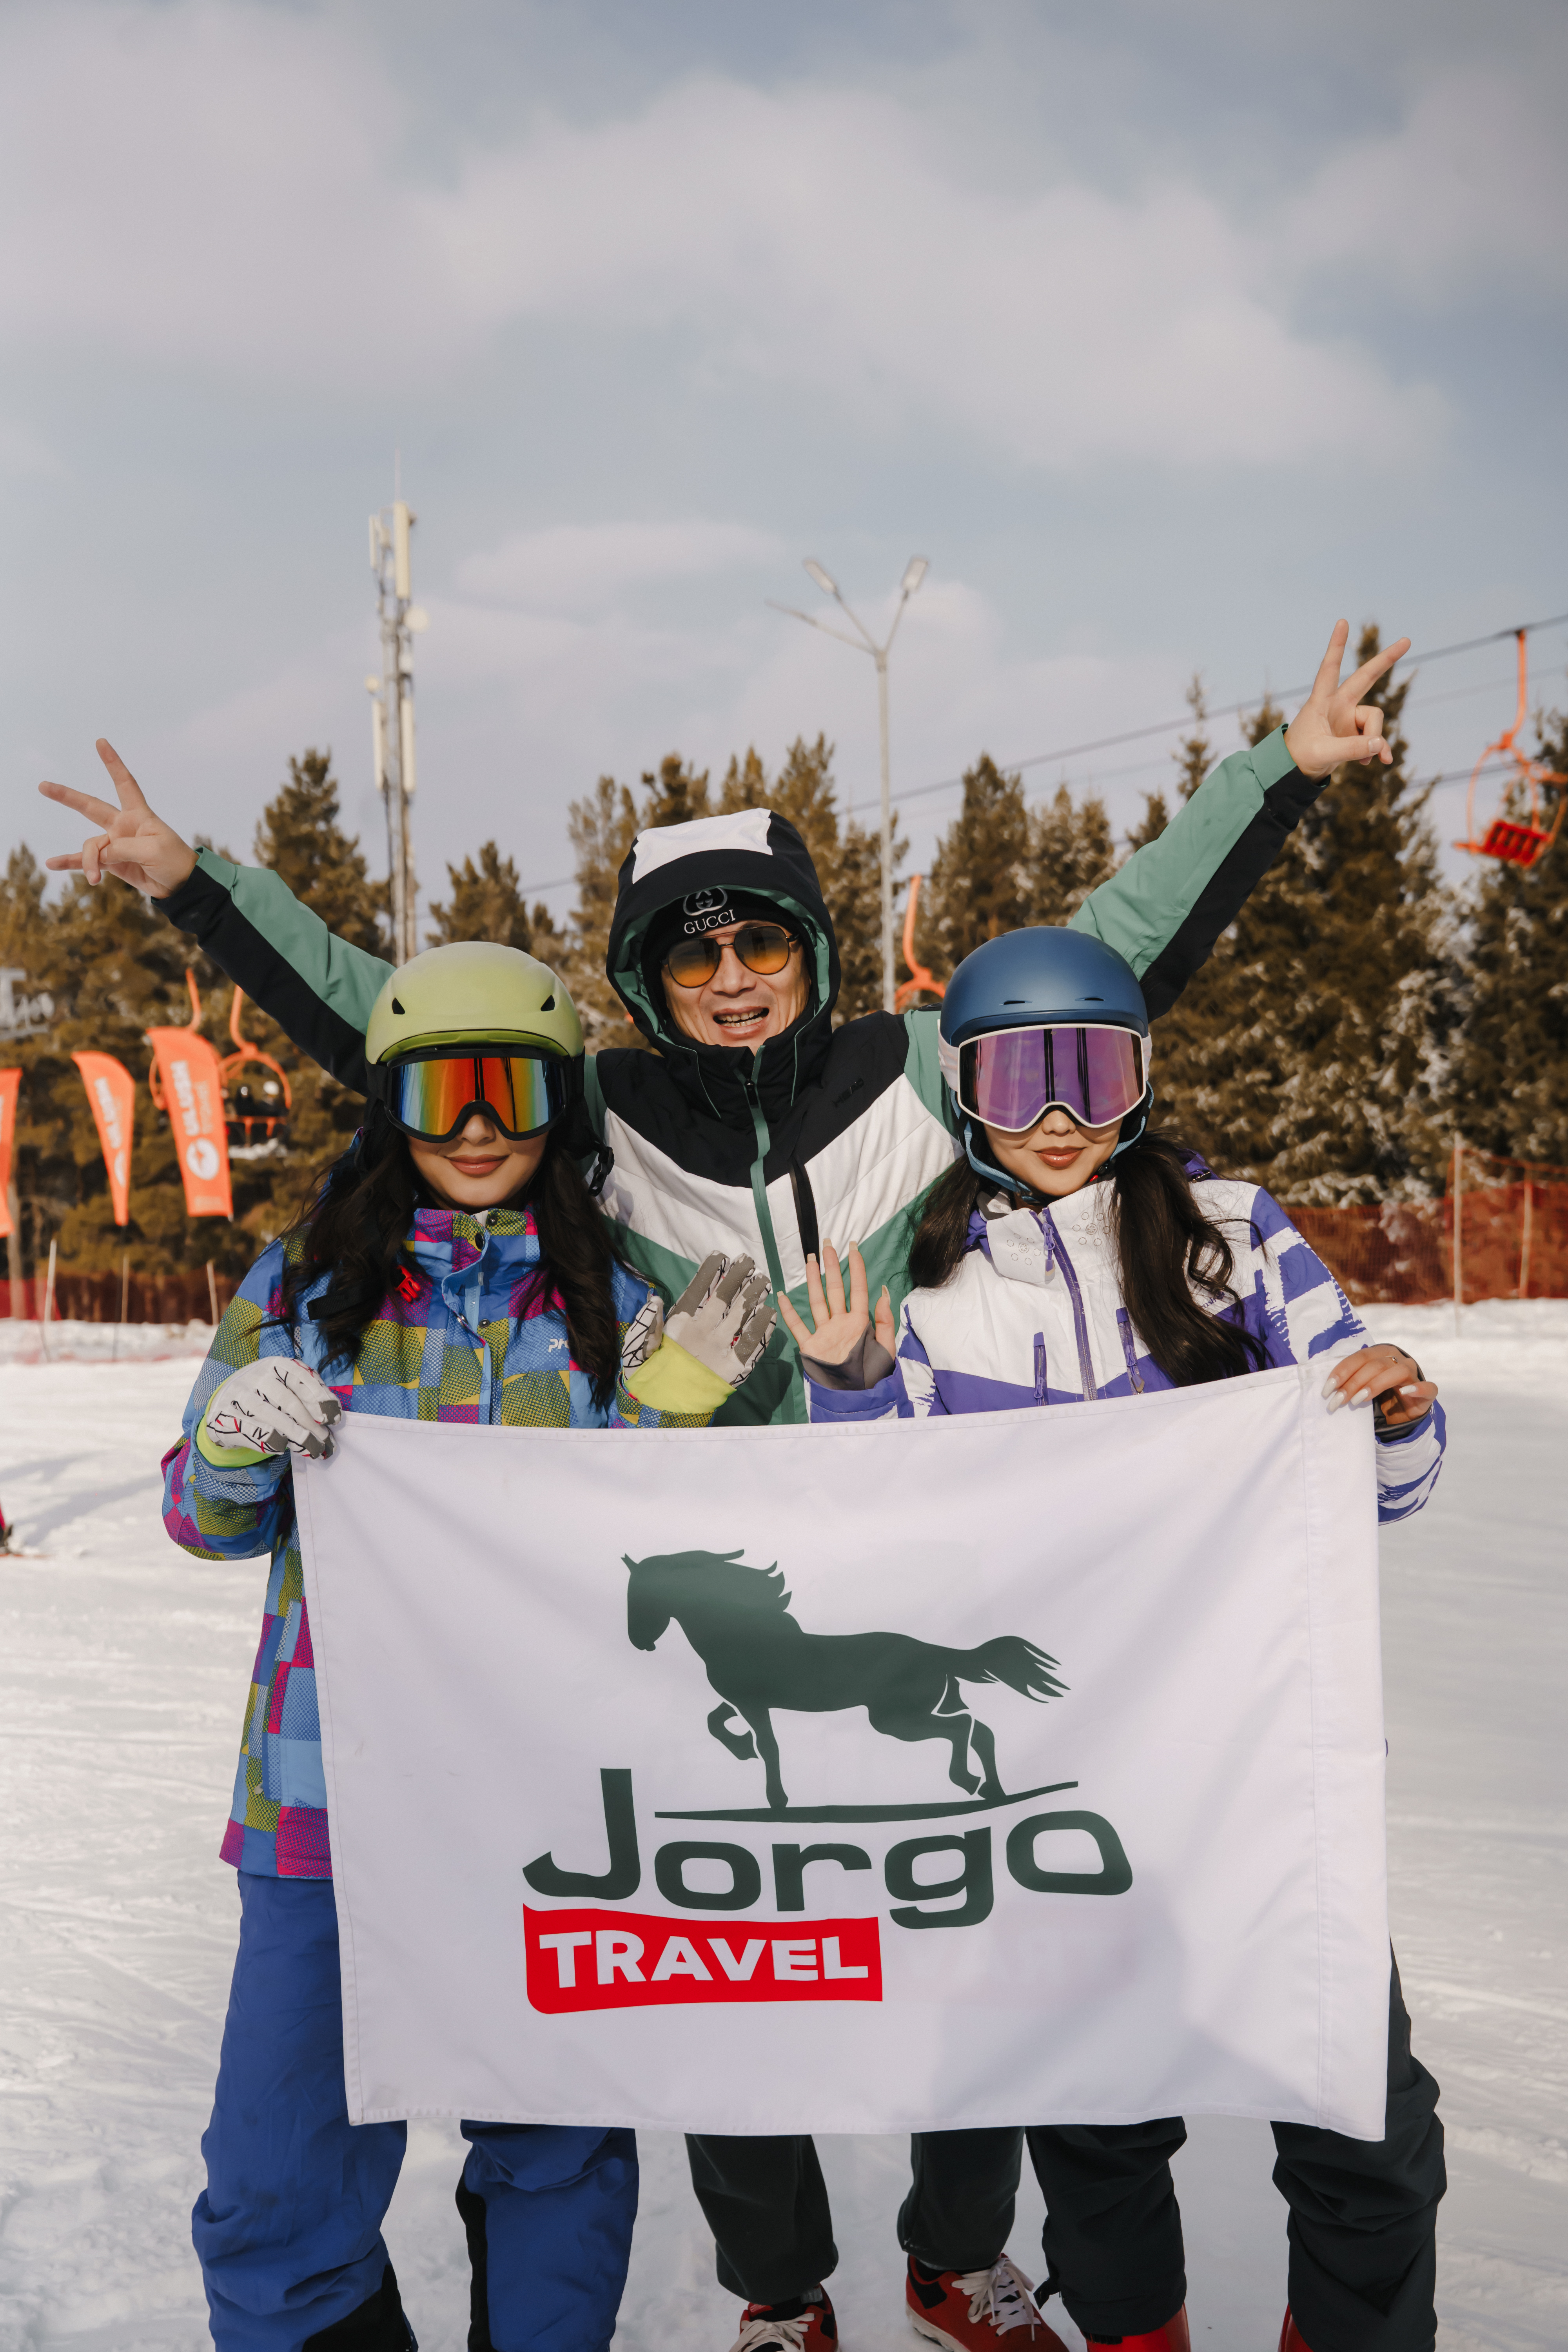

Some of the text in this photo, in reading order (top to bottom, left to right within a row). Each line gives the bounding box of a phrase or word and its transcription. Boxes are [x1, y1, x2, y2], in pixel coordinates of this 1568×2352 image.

[684, 909, 736, 934] GUCCI
[523, 1768, 1133, 1929] Jorgo
[539, 1930, 869, 1988] TRAVEL
